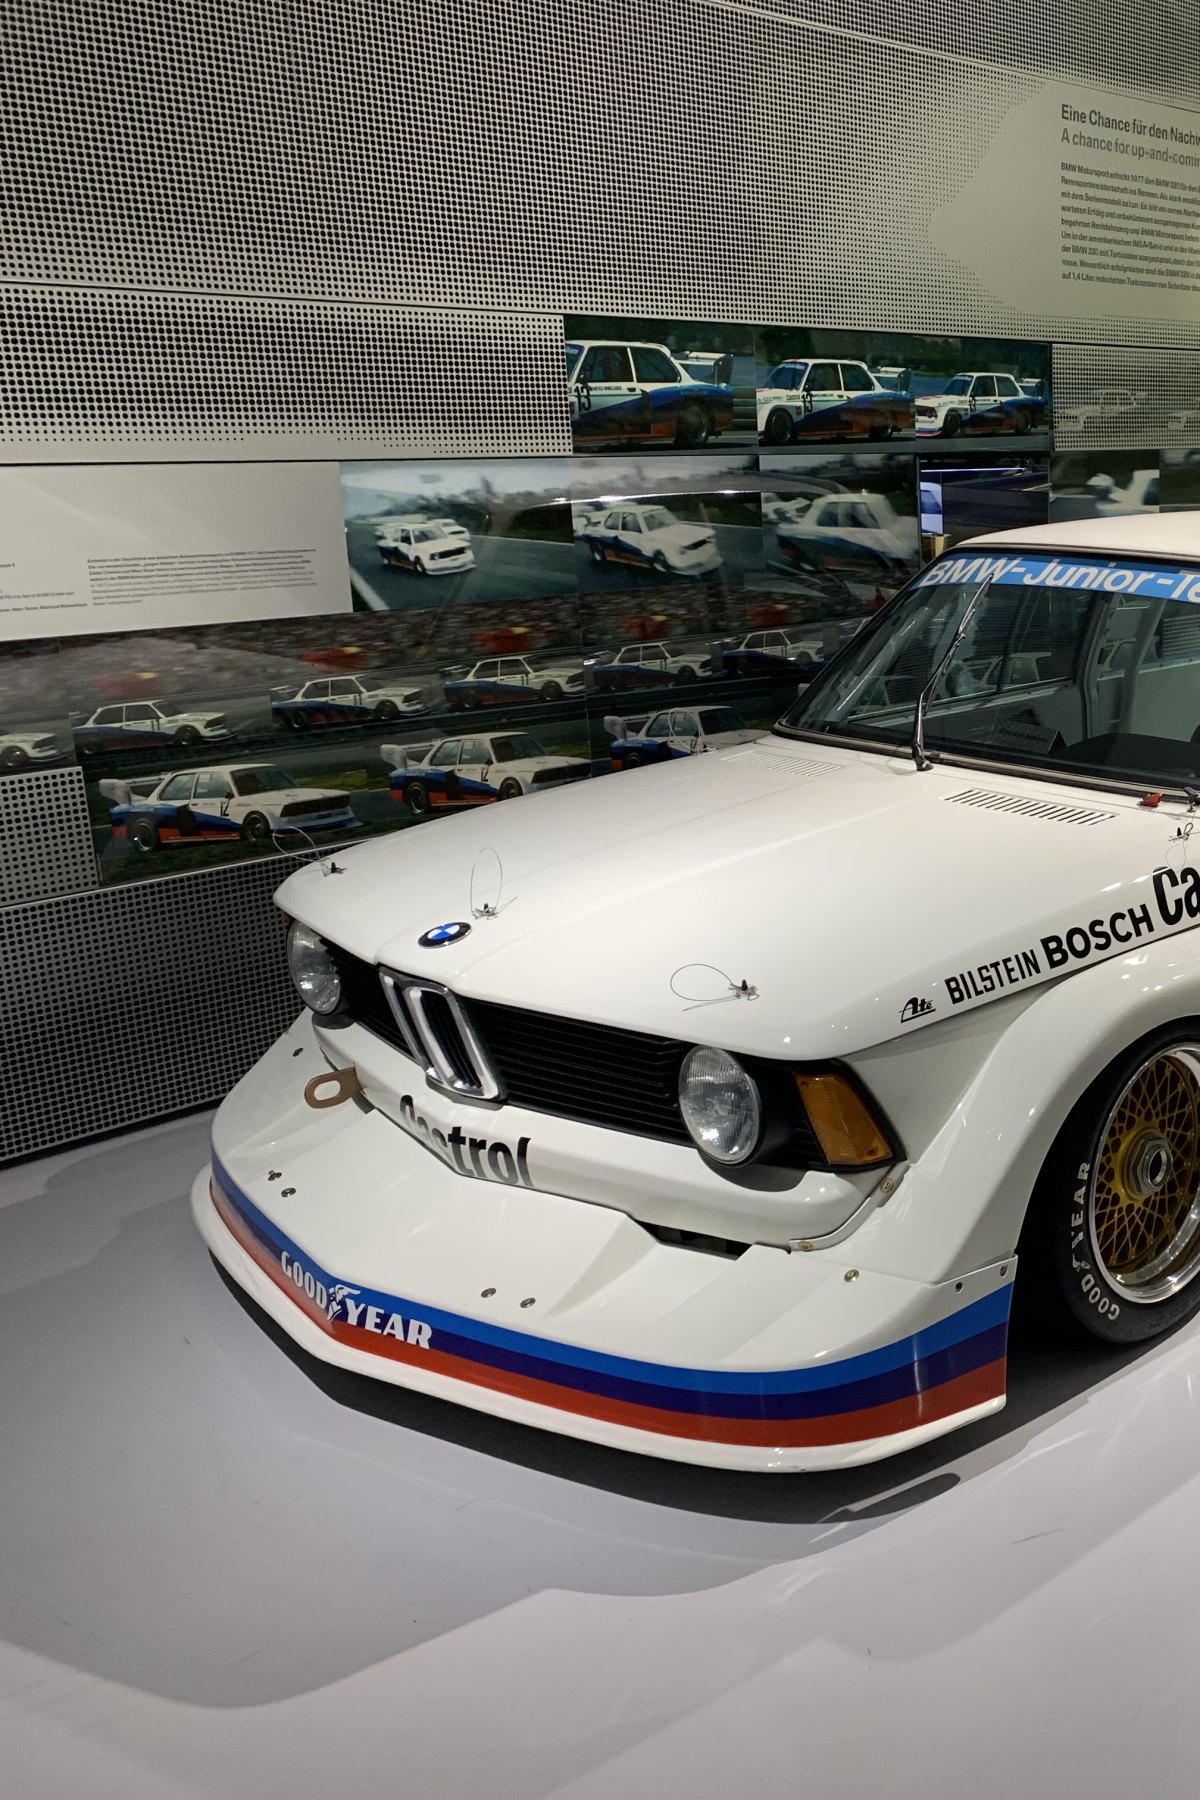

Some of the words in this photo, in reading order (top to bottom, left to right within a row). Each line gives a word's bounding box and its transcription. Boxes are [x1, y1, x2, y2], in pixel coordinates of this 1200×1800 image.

[1061, 103, 1087, 124] Eine
[1088, 109, 1130, 133] Chance
[1132, 119, 1148, 136] für
[1149, 123, 1168, 140] den
[1061, 127, 1070, 144] A
[1072, 131, 1112, 152] chance
[1114, 138, 1130, 155] for
[1077, 165, 1109, 179] Motorsport
[1040, 903, 1155, 970] BOSCH
[944, 949, 1042, 1005] BILSTEIN
